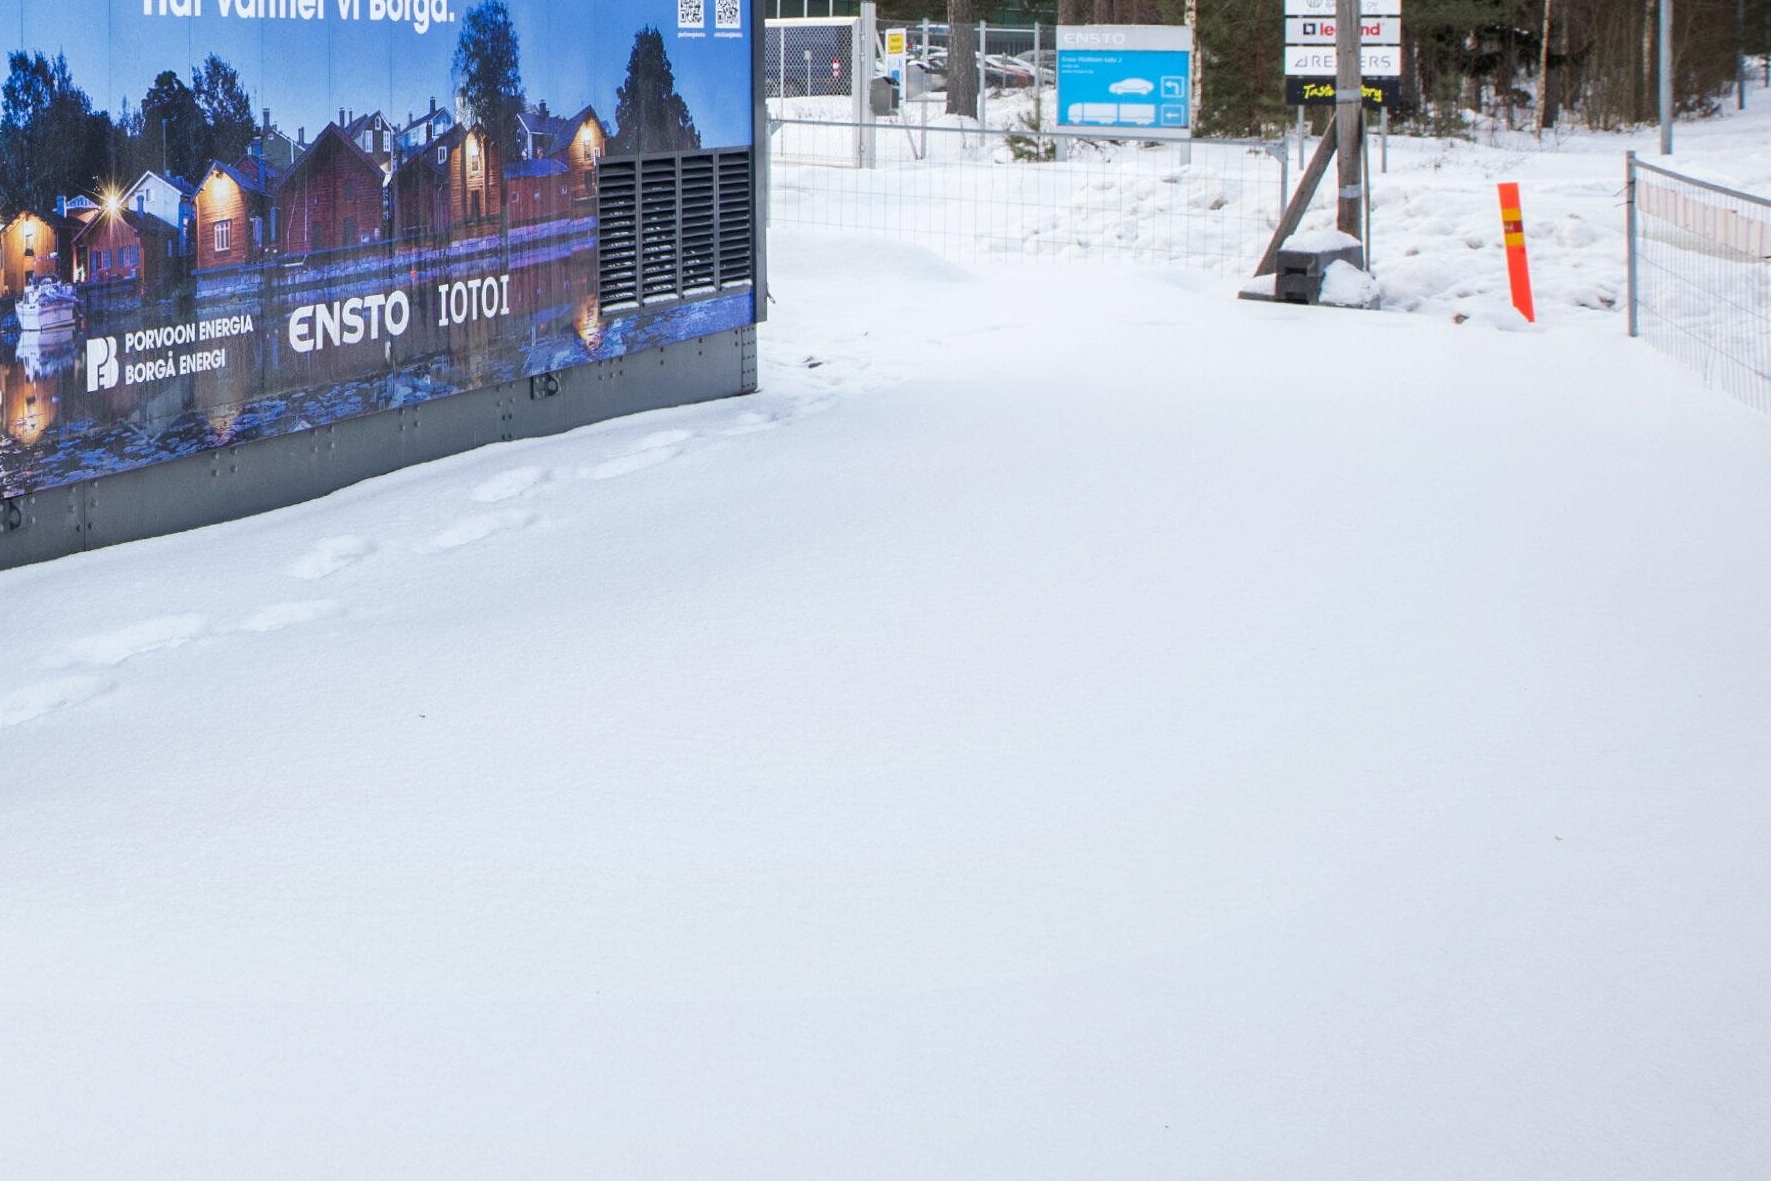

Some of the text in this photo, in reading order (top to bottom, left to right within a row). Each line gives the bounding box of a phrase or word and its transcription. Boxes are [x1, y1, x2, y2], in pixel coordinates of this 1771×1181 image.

[1063, 32, 1126, 45] ENSTO
[1320, 22, 1381, 36] lend
[1303, 83, 1336, 99] Taste
[125, 314, 254, 354] PORVOON ENERGIA
[288, 290, 410, 353] ENSTO
[125, 347, 226, 385] BORGÅ ENERGI
